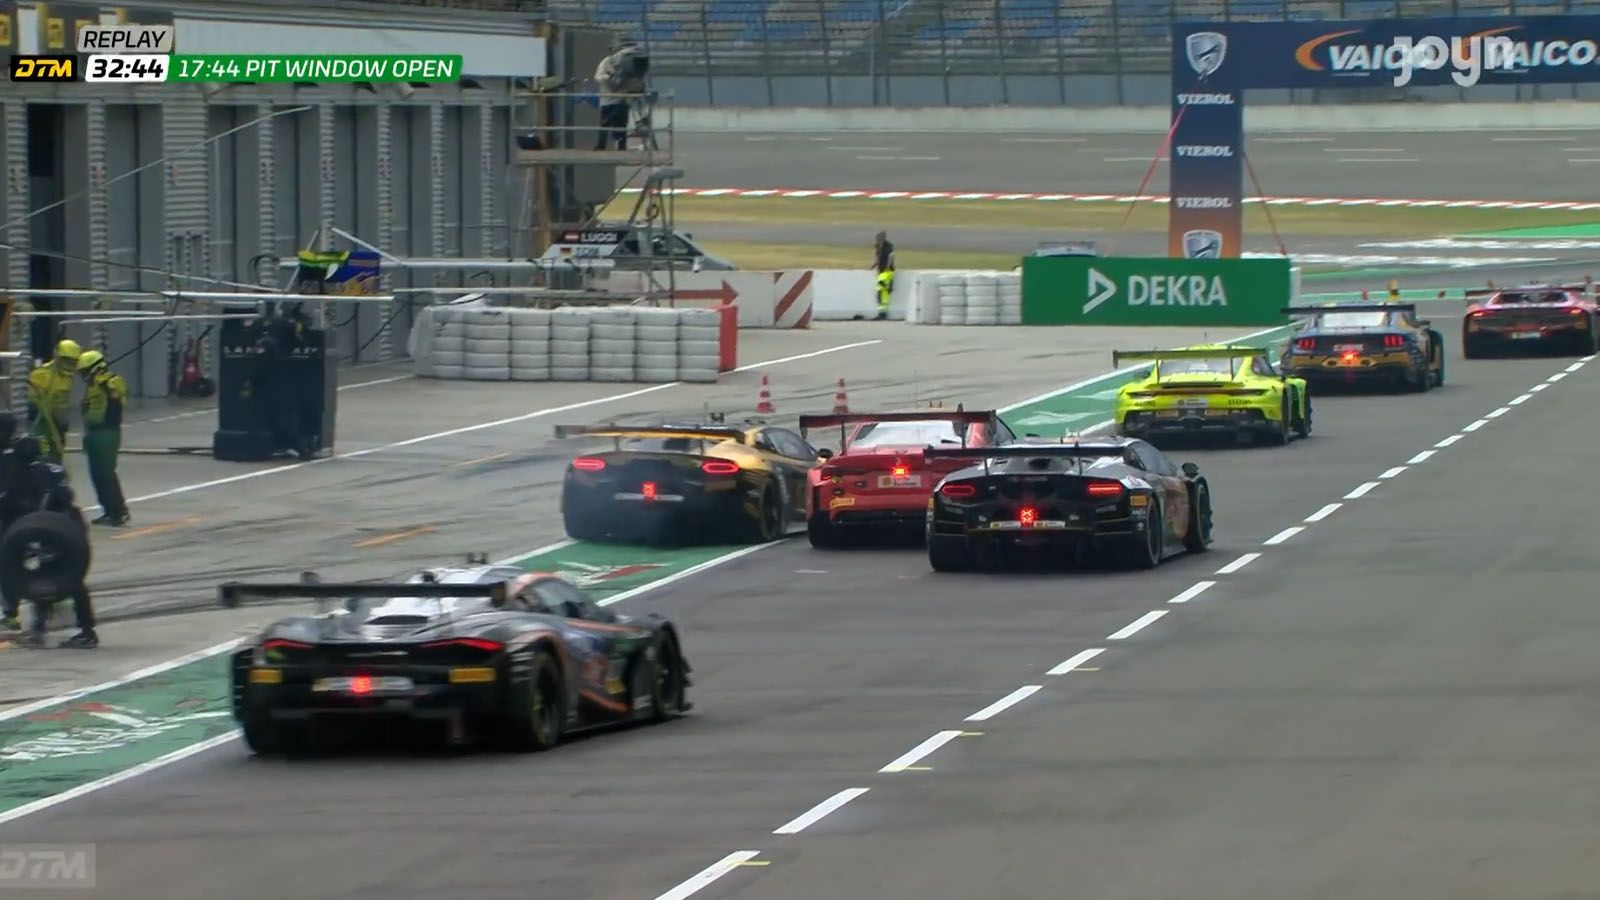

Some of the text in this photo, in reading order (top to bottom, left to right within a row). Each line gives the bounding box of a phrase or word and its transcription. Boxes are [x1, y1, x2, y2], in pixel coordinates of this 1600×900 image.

[1176, 145, 1233, 157] VIEROL
[1176, 197, 1232, 209] VIEROL
[1127, 274, 1227, 306] DEKRA
